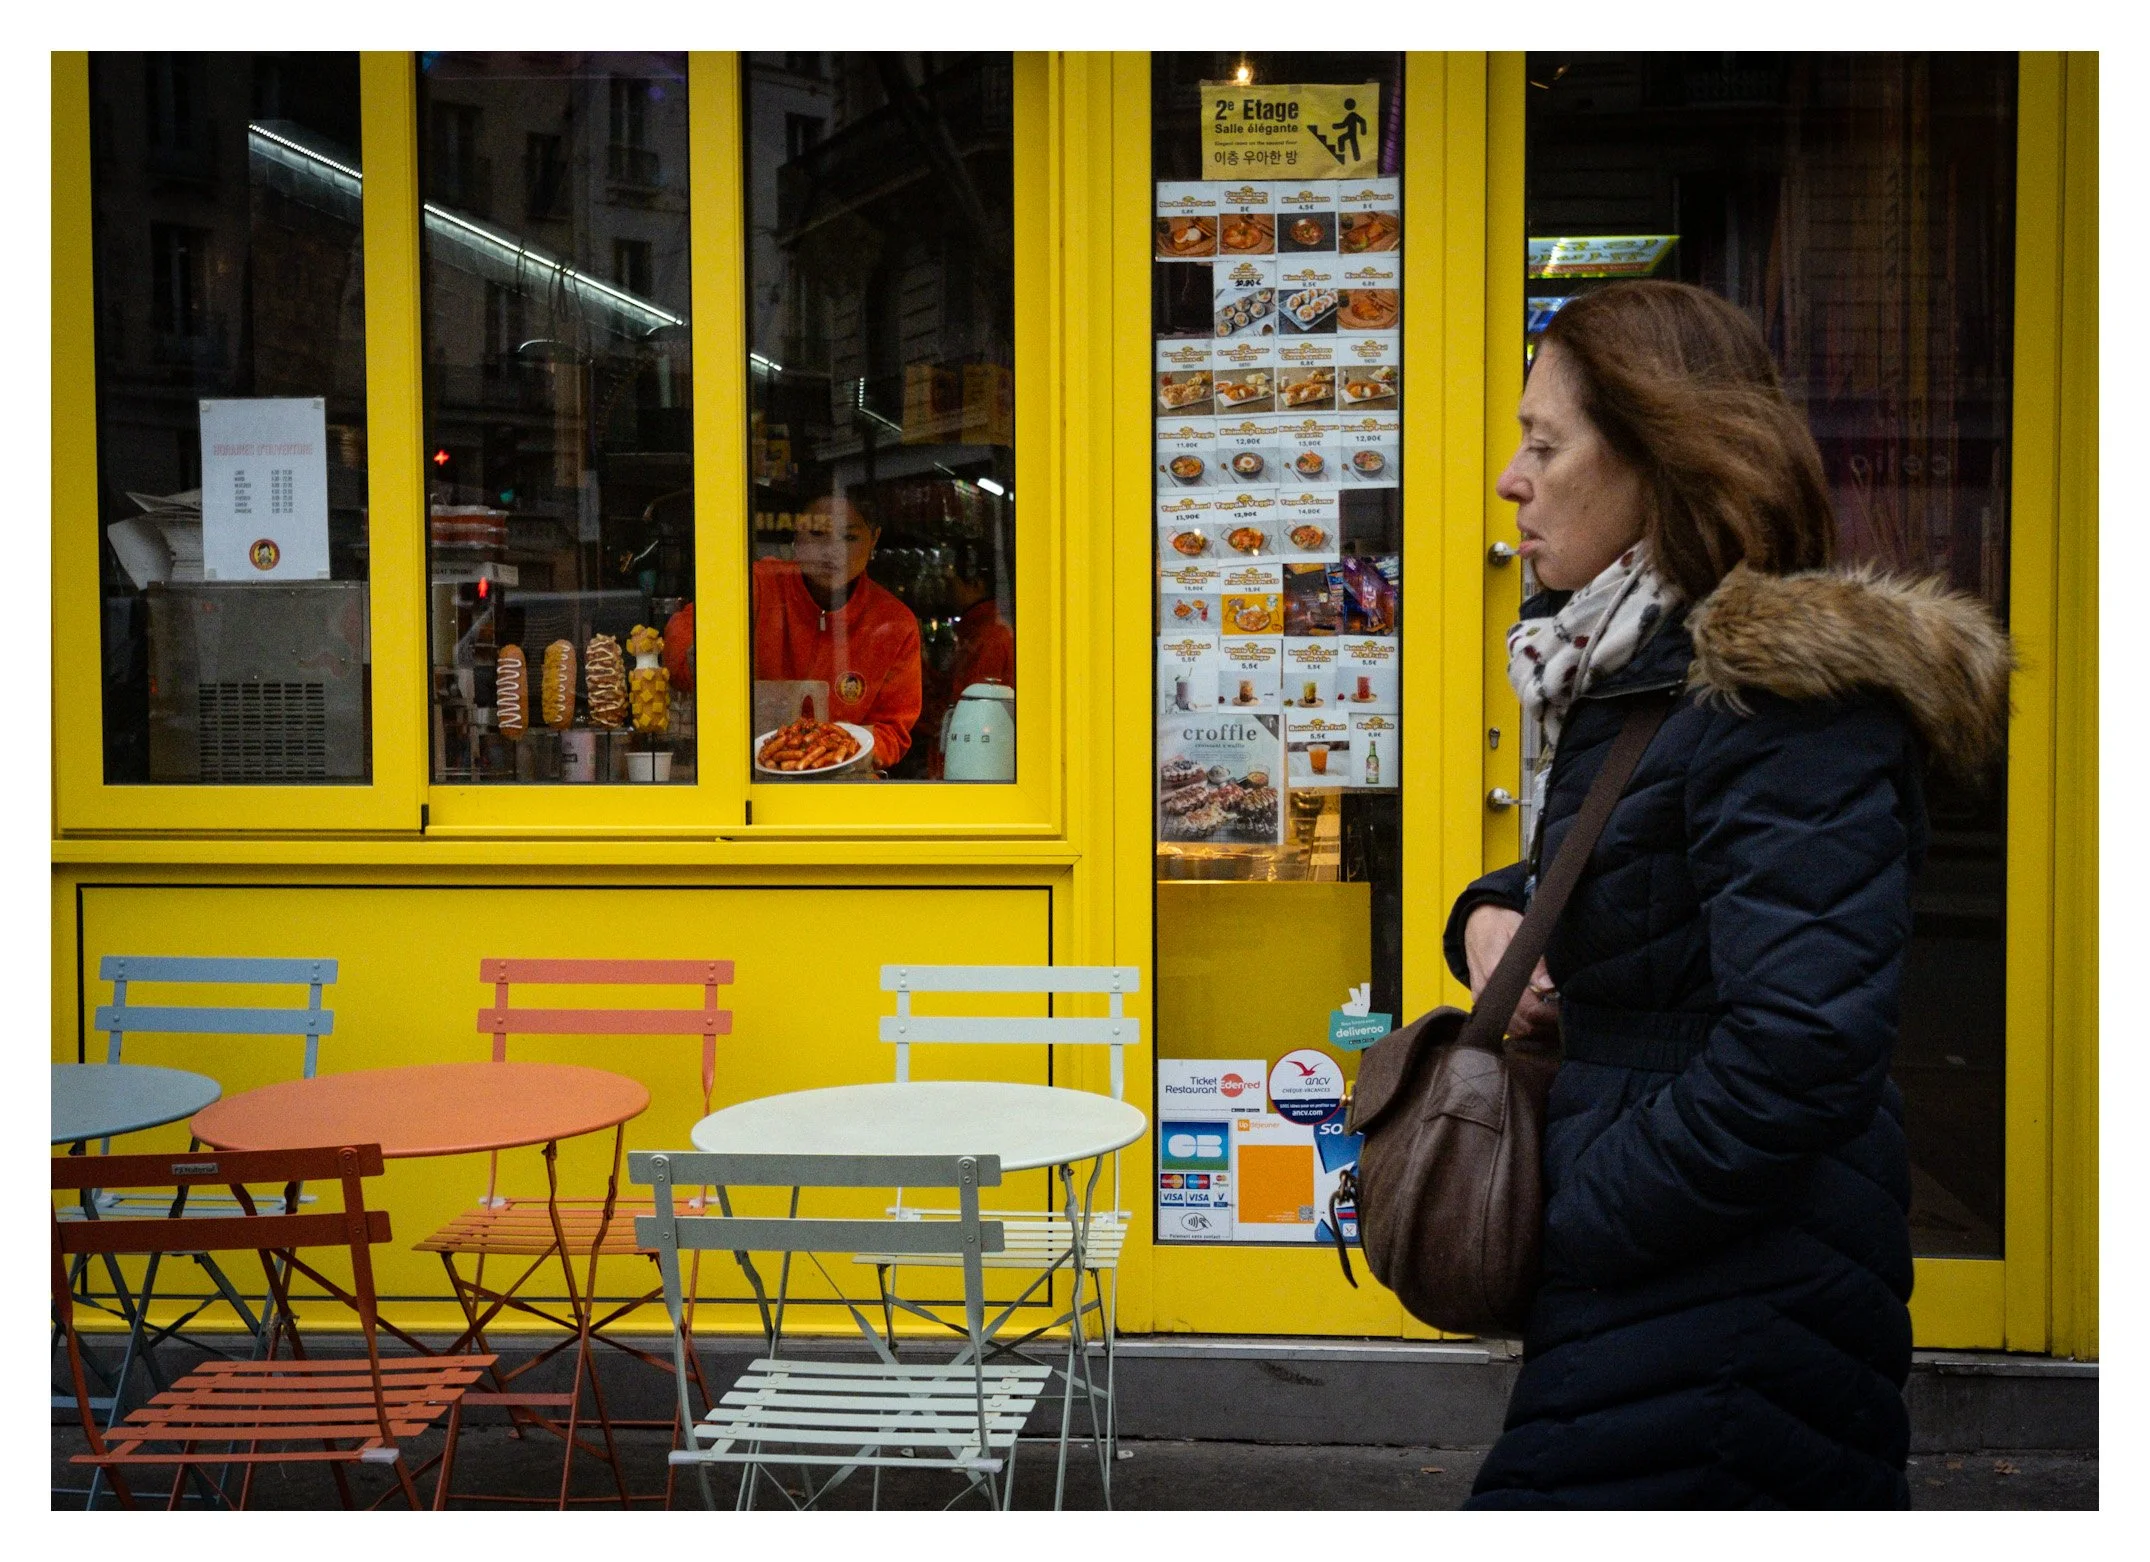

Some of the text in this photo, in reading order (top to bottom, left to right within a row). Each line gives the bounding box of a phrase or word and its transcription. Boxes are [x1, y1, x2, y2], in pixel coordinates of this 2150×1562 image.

[1243, 99, 1299, 123] Etage
[1215, 123, 1299, 136] Salle élégante
[1243, 150, 1282, 166] 우아한
[1286, 150, 1298, 166] 방
[1248, 499, 1275, 507] Veggie
[1182, 723, 1257, 741] croffle
[1335, 1025, 1385, 1039] deliveroo
[1190, 1076, 1217, 1086] Ticket
[1220, 1080, 1260, 1090] Edenred
[1305, 1077, 1331, 1086] ancv
[1165, 1085, 1217, 1094] Restaurant
[1291, 1109, 1324, 1117] ancv.com
[1238, 1121, 1249, 1130] Up
[1168, 1134, 1223, 1158] CB
[1163, 1192, 1184, 1201] VISA
[1189, 1193, 1210, 1202] VISA
[1217, 1192, 1226, 1201] V
